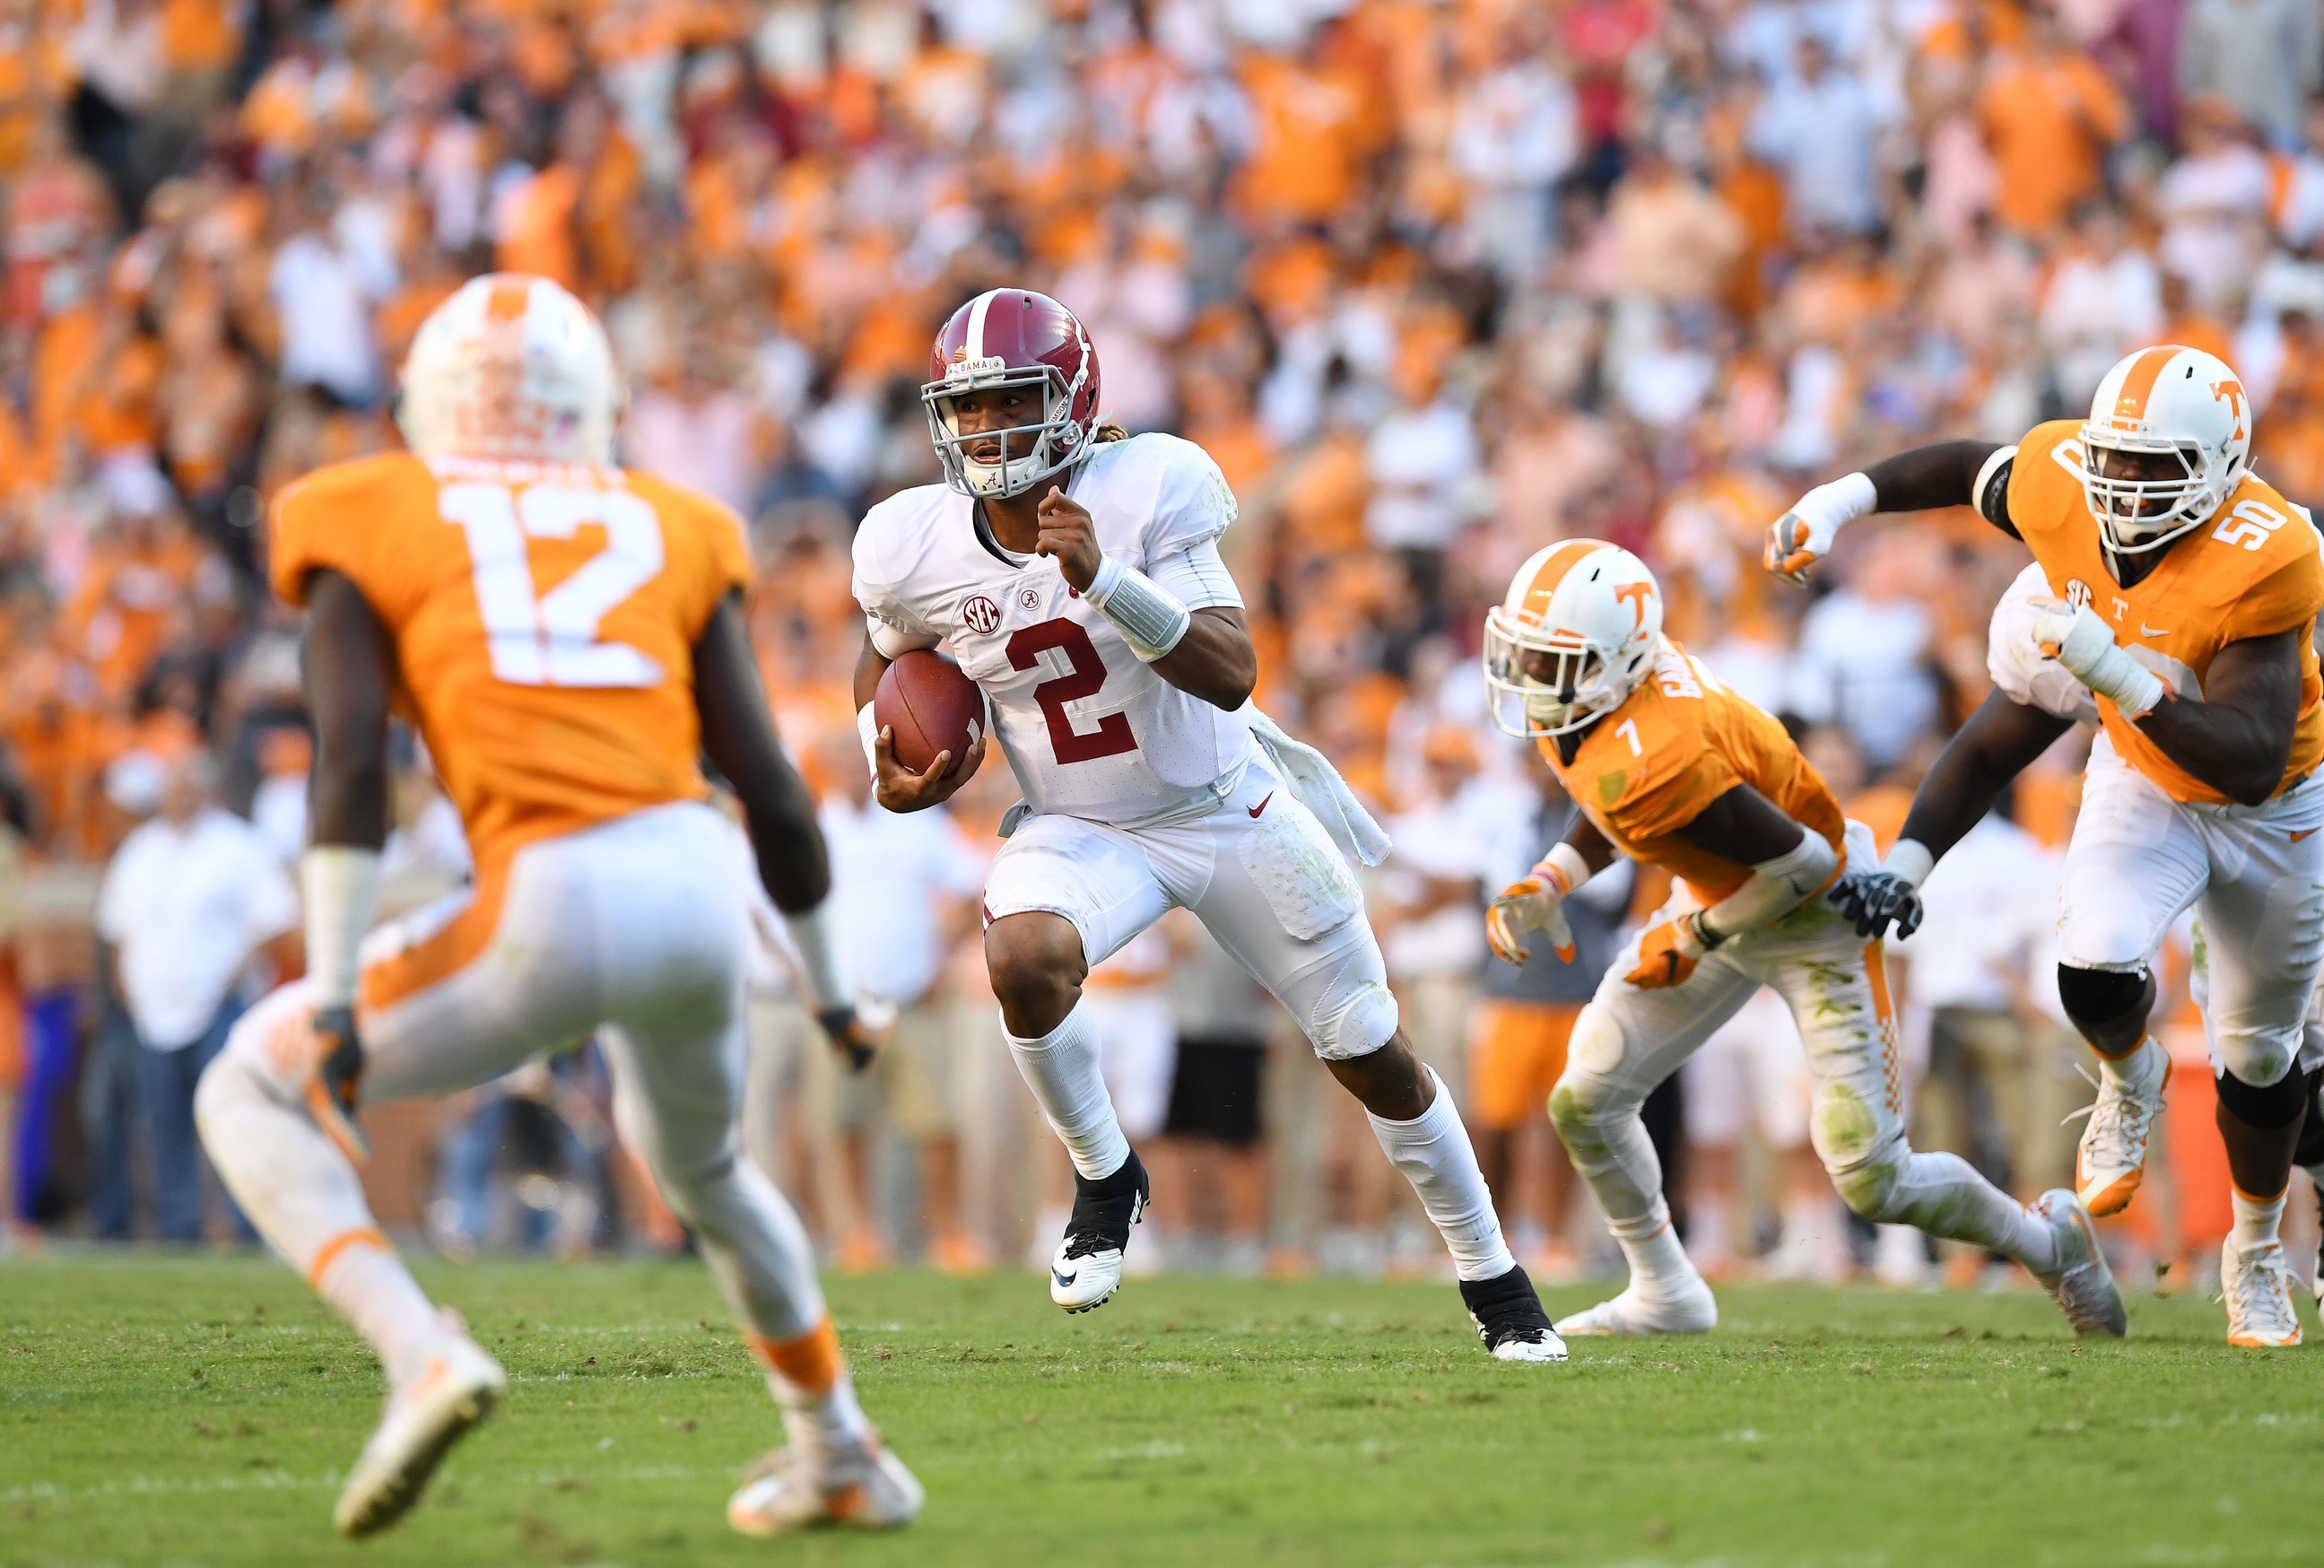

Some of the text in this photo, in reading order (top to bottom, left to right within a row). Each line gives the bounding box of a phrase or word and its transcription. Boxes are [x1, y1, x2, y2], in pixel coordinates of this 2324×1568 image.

[961, 360, 988, 372] BAMA
[2211, 499, 2287, 551] 50
[438, 483, 667, 687] 12
[964, 597, 999, 632] SEC
[2111, 596, 2129, 622] T
[1005, 616, 1139, 765] 2
[1614, 717, 1643, 758] 7
